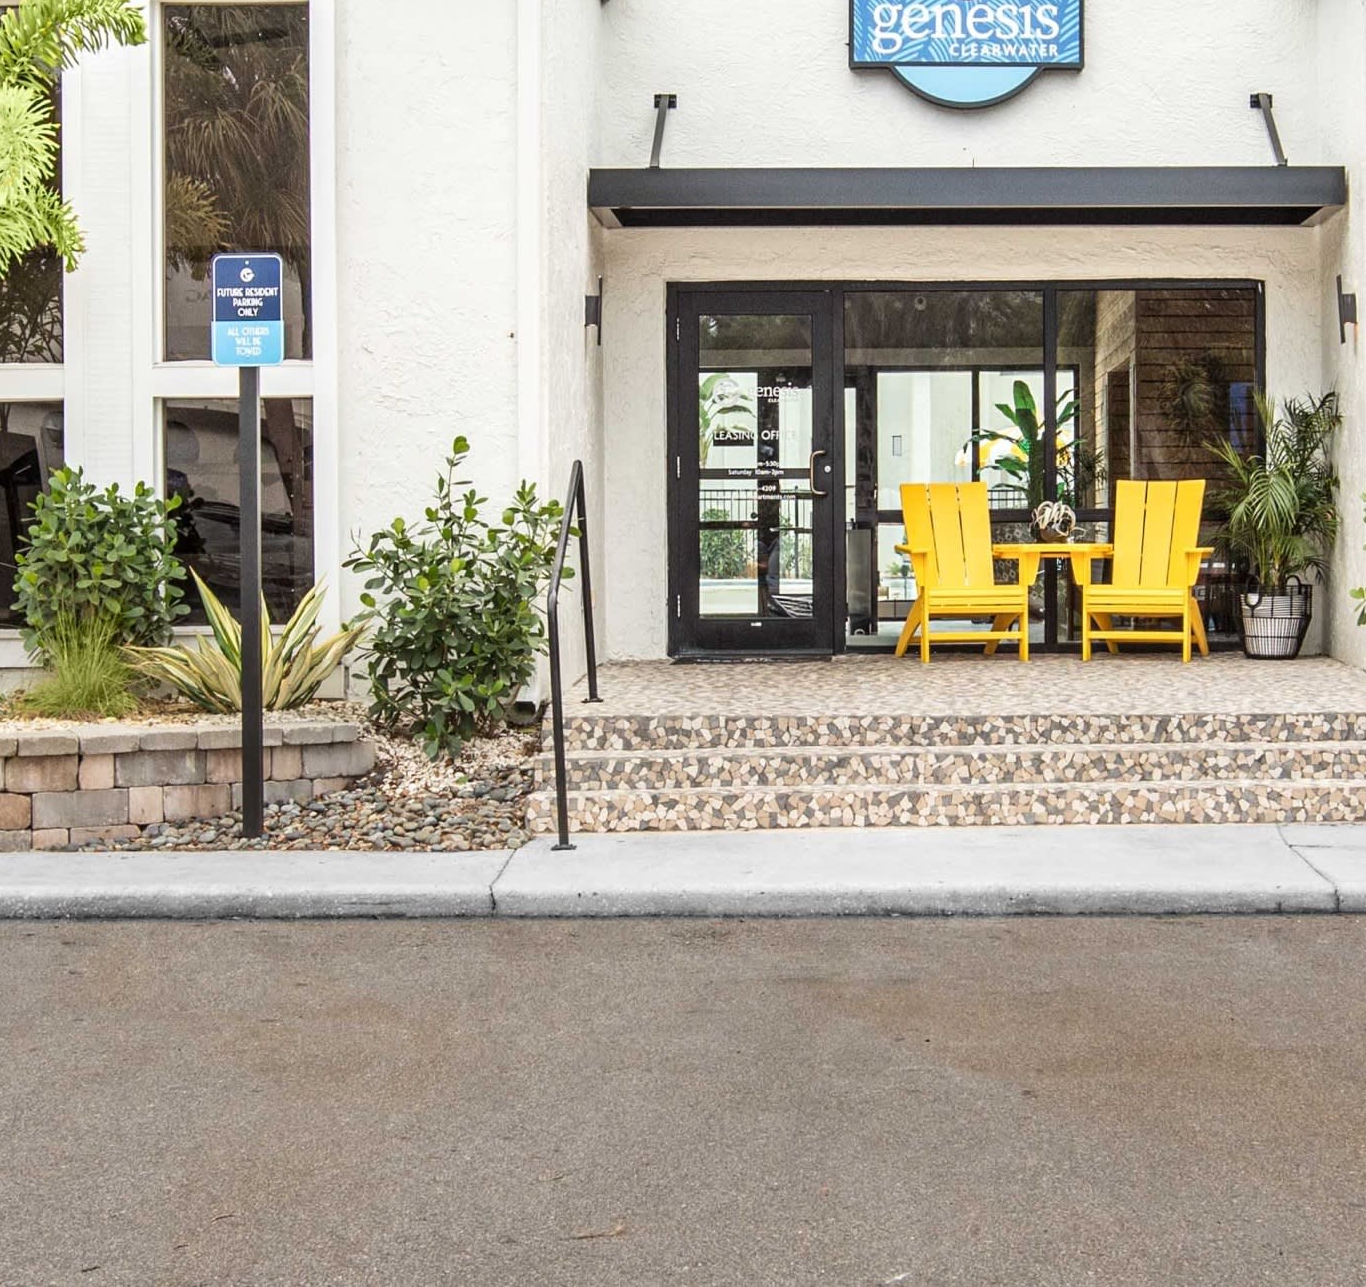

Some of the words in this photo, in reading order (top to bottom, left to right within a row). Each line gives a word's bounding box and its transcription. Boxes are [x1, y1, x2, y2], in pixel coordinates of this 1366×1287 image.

[948, 43, 1059, 58] CLEARWATER
[217, 287, 244, 297] FUTURE
[245, 287, 279, 297] RESIDENT
[232, 297, 264, 307] PARKING
[237, 307, 259, 317] ONLY
[227, 326, 239, 336] ALL
[241, 326, 270, 336] OTHERS
[234, 336, 250, 346] WILL
[251, 336, 261, 346] BE
[235, 346, 262, 356] TOWED
